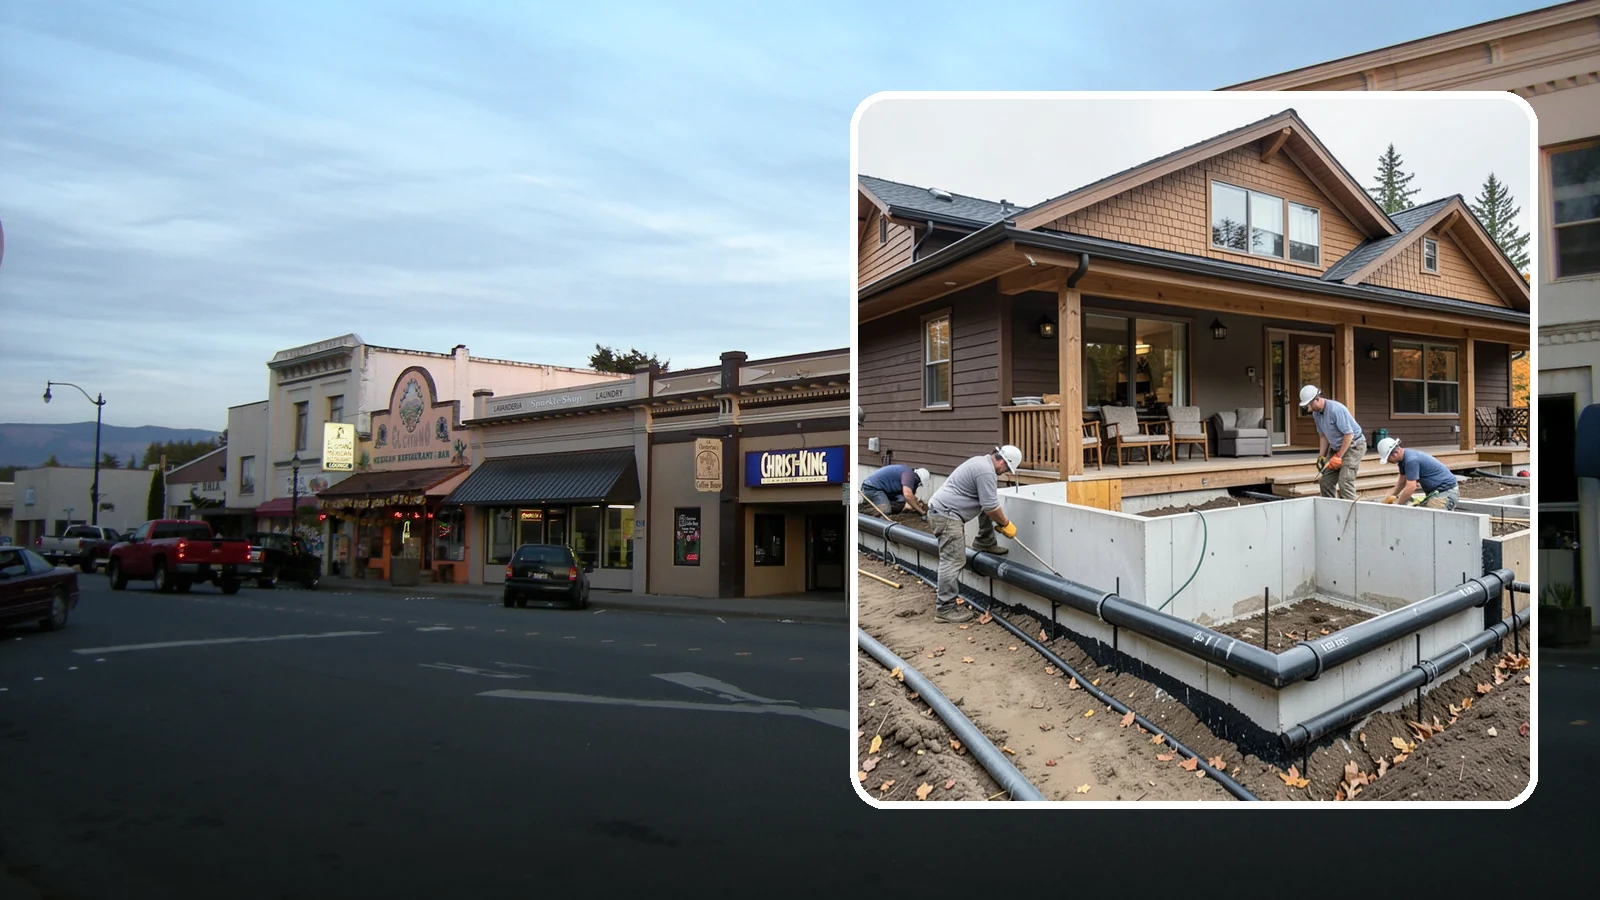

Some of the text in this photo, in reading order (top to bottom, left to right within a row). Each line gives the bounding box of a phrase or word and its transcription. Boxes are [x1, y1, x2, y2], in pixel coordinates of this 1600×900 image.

[530, 394, 582, 408] Sparkle Shop
[595, 389, 624, 400] LAUNDRY
[493, 402, 522, 413] LAVANDERIA
[373, 455, 396, 464] MEXICAN
[397, 451, 433, 462] RESTAURANT
[438, 450, 450, 459] BAR
[760, 450, 828, 478] CHRIST KING
